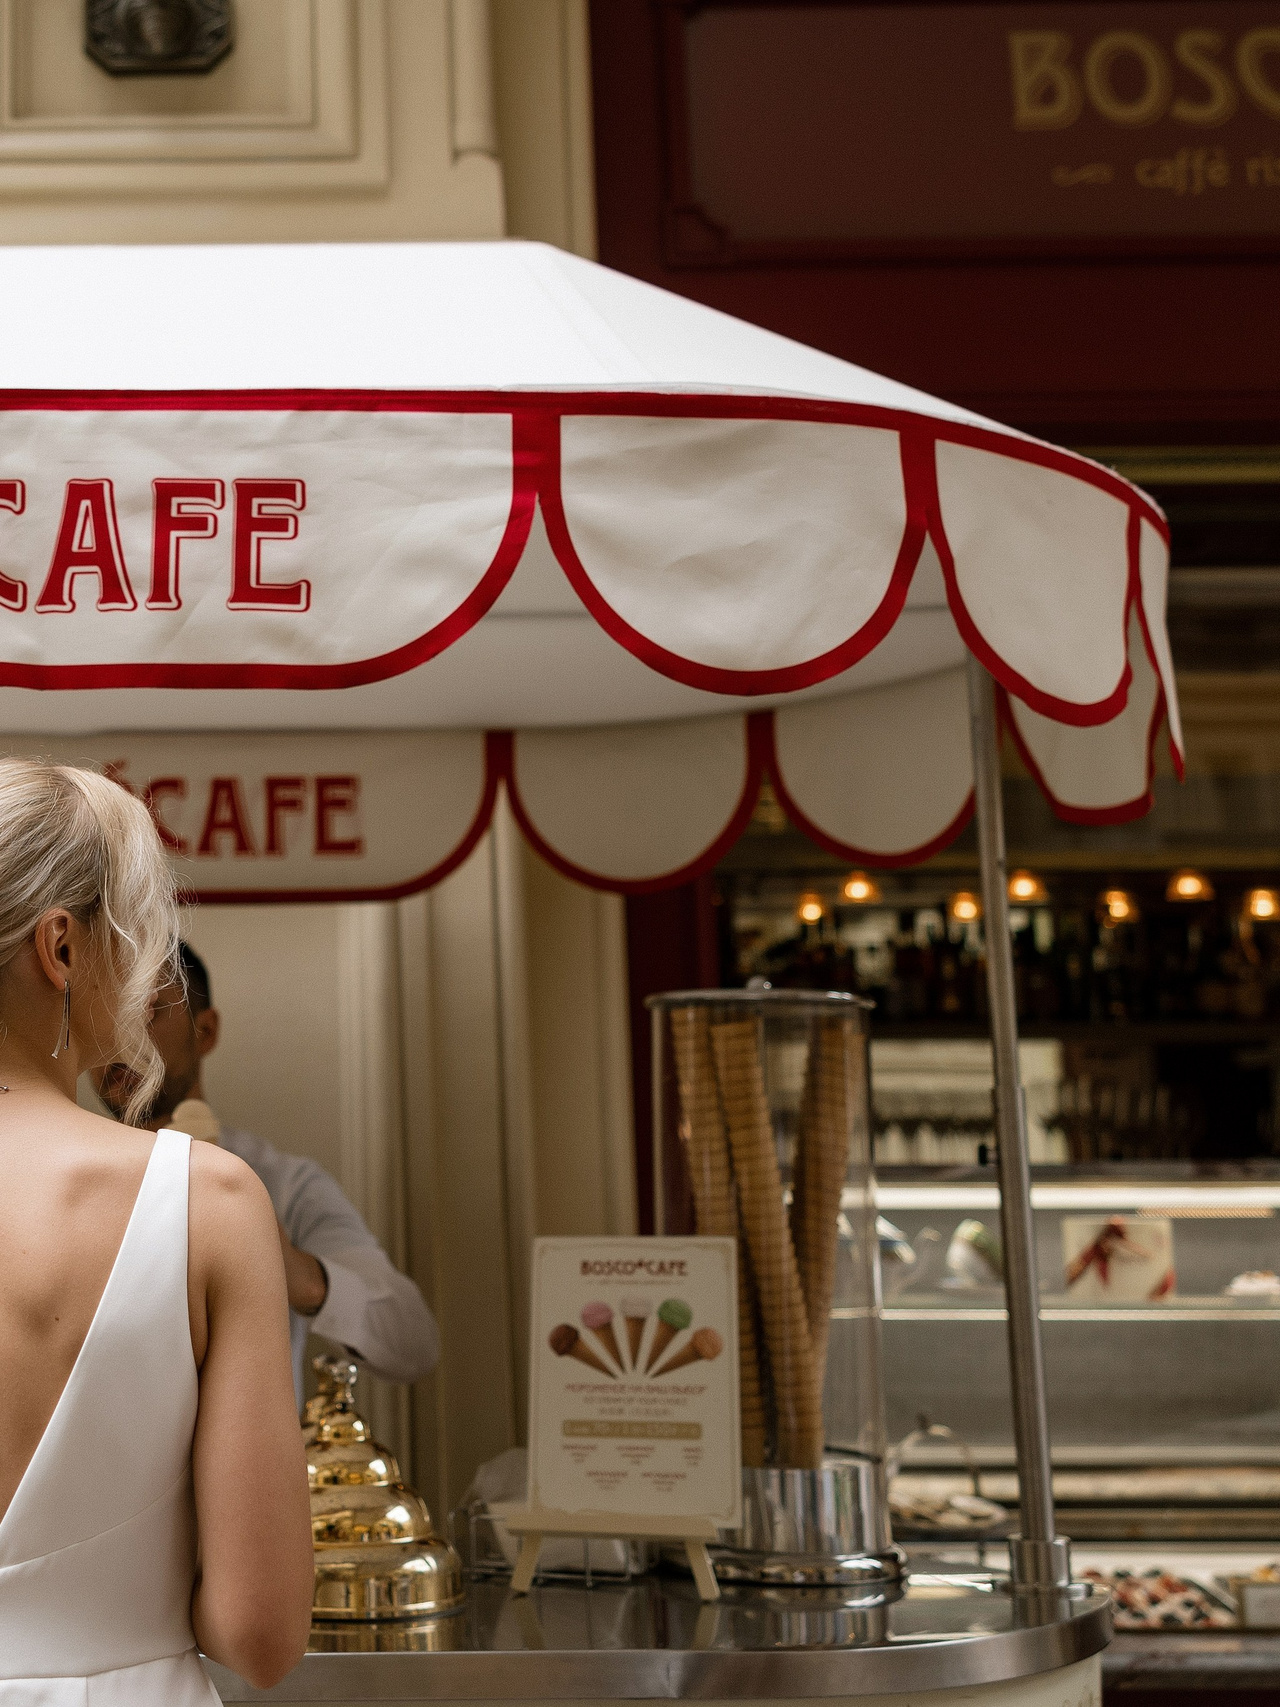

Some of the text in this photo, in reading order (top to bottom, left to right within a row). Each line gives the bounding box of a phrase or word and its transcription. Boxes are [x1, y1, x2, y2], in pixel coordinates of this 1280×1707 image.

[144, 776, 361, 856] CAFE
[581, 1259, 687, 1277] BOSCO CAFE
